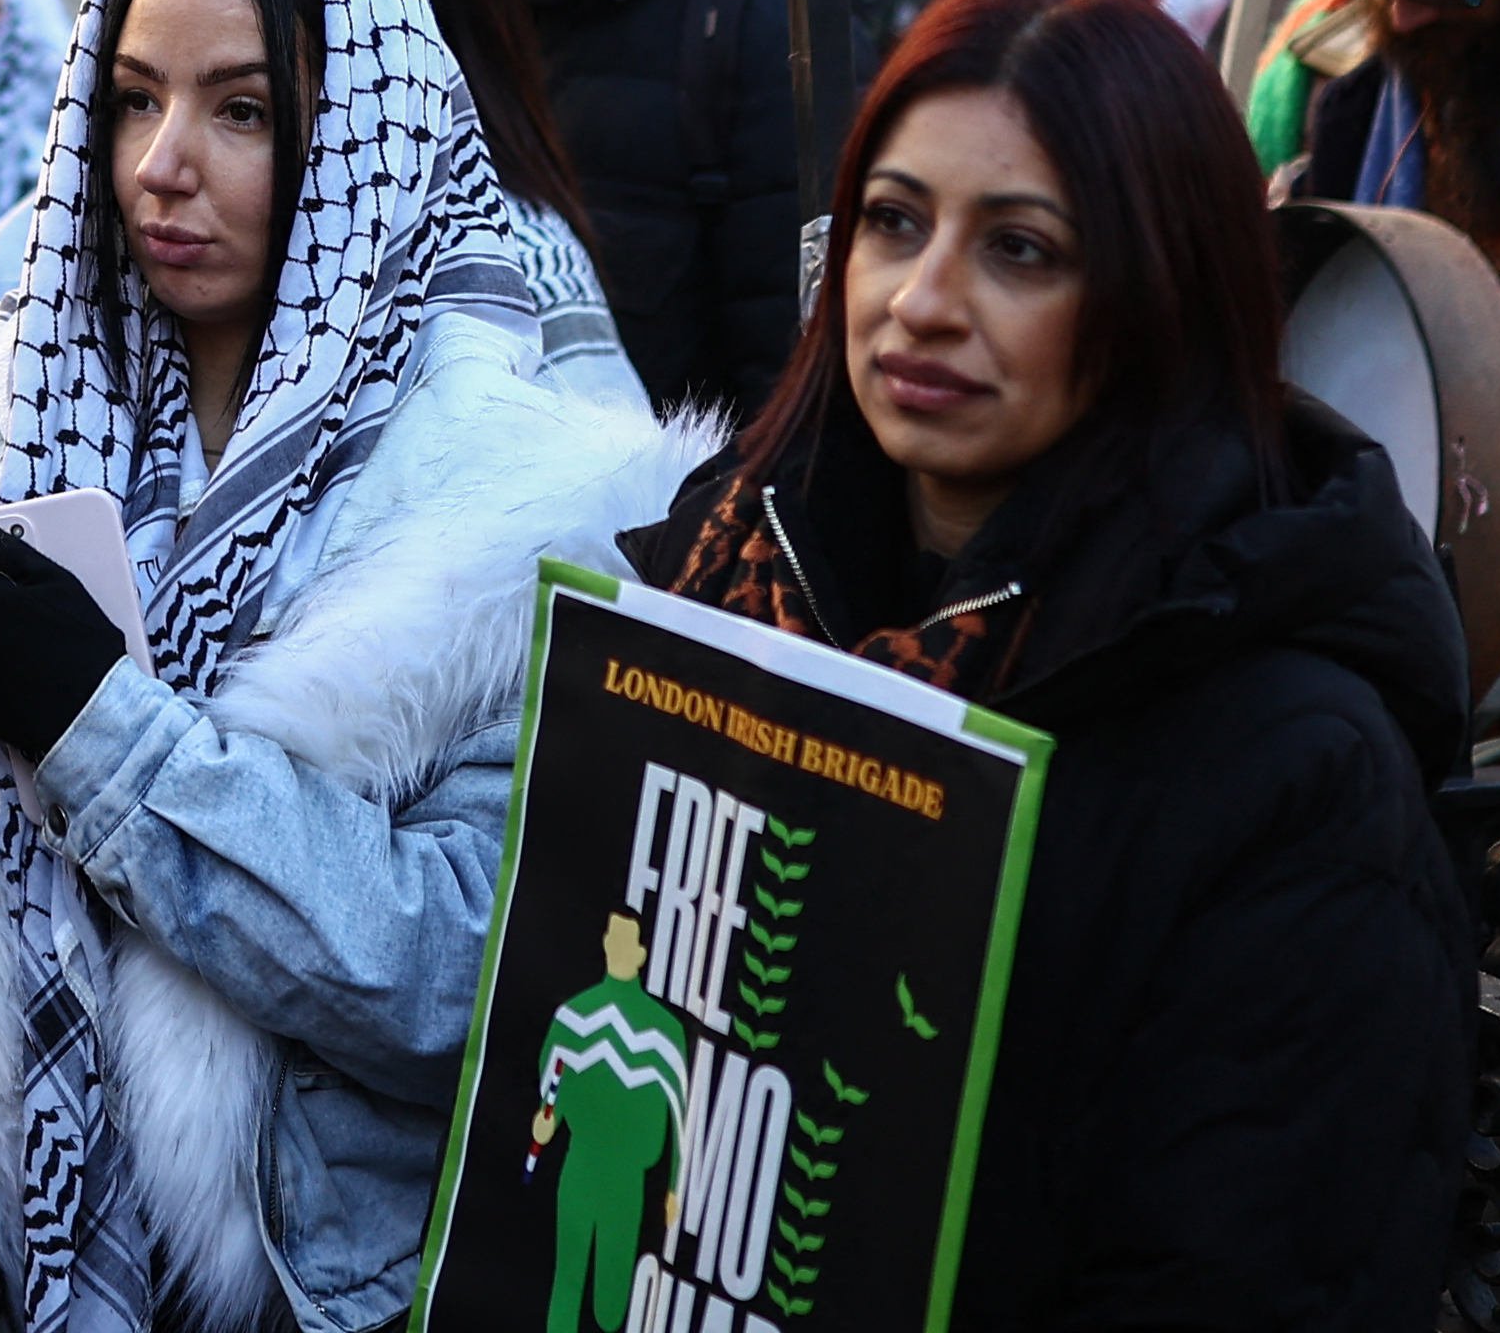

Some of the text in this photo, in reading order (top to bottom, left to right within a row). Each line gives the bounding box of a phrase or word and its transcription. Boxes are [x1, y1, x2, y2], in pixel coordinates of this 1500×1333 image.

[605, 658, 946, 822] LONDON IRISH BRIGADE
[626, 761, 766, 1035] FREE
[663, 1038, 792, 1301] MO
